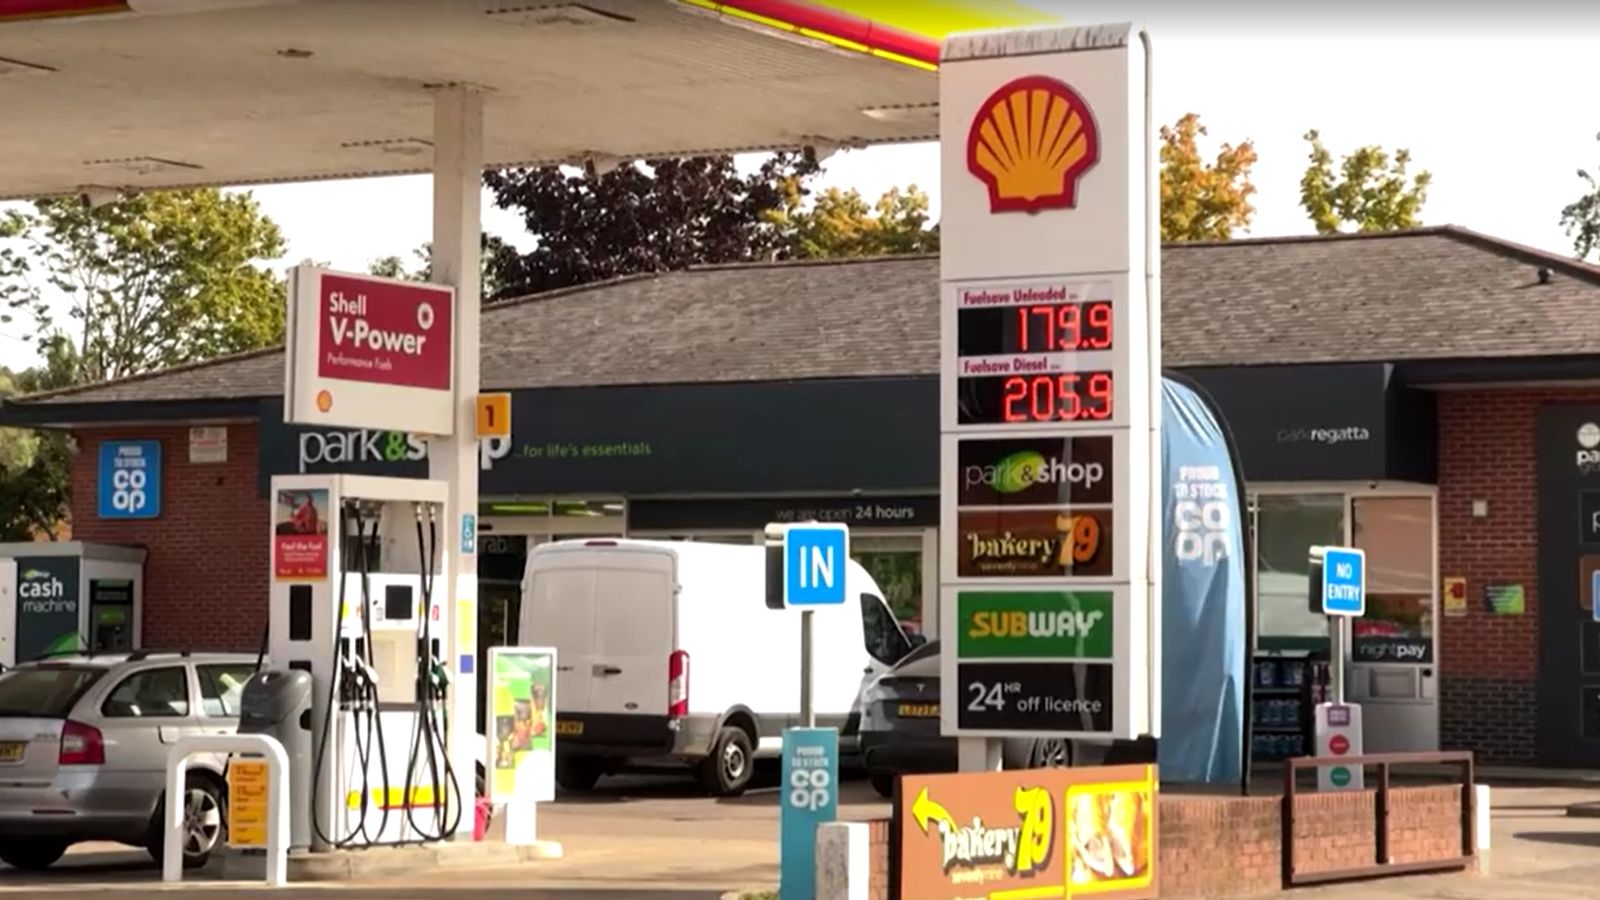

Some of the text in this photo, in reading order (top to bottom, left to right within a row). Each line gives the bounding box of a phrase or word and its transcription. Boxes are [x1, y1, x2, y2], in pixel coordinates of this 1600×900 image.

[329, 291, 367, 315] Shell
[964, 291, 1010, 305] Fuelsave
[1013, 287, 1066, 300] Unleaded
[329, 316, 426, 355] V-Power
[1018, 303, 1113, 351] 179.9
[964, 360, 1010, 373] Fuelsave
[1013, 357, 1047, 370] Diesel
[1004, 374, 1113, 422] 205.9
[485, 404, 495, 427] 1
[546, 443, 578, 458] life's
[581, 441, 653, 457] essentials
[966, 457, 1104, 491] park&shop
[855, 505, 873, 519] 24
[875, 504, 915, 519] hours
[967, 515, 1100, 567] bakery 79
[800, 545, 834, 589] IN
[1336, 562, 1353, 580] NO
[19, 577, 64, 598] cash
[1328, 583, 1361, 602] ENTRY
[23, 600, 77, 613] machine
[968, 609, 1104, 639] SUBWAY
[1016, 696, 1041, 712] off
[1044, 696, 1102, 712] licence
[938, 786, 1054, 872] bakery 79
